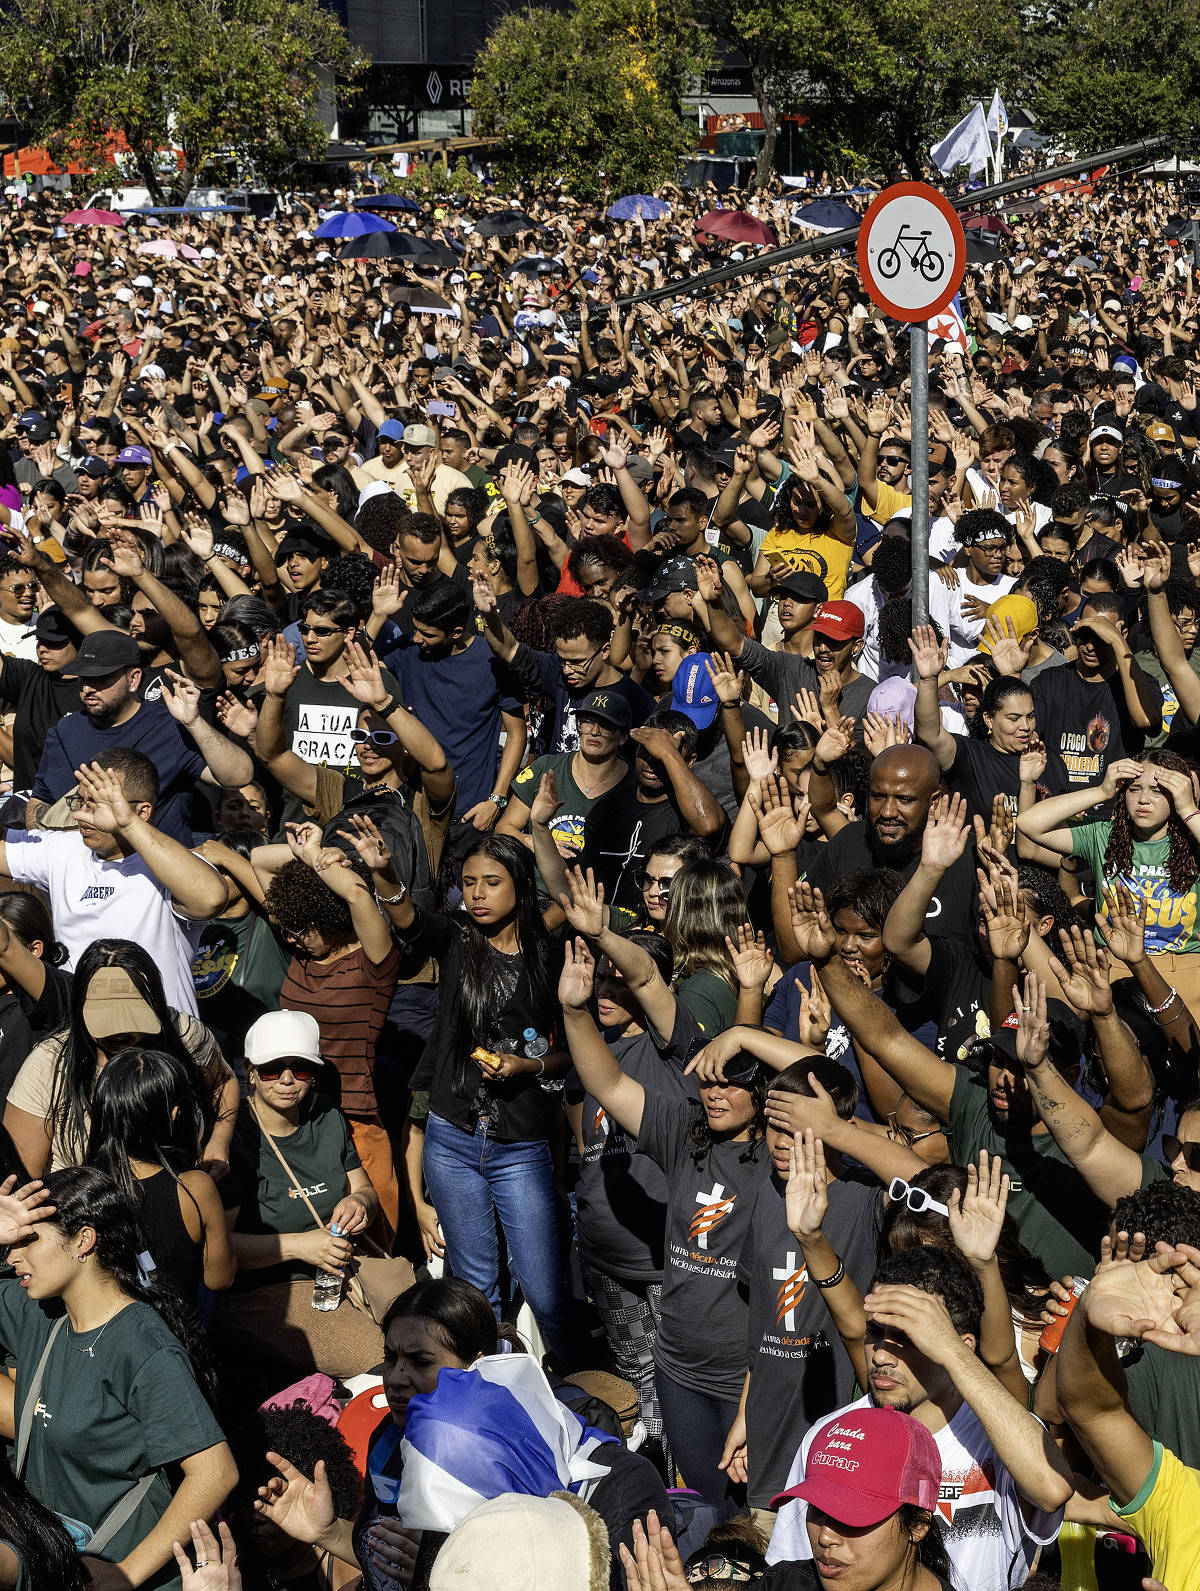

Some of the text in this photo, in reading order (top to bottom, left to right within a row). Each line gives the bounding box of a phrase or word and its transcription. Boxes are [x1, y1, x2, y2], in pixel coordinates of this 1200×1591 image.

[712, 77, 741, 87] Amazonas
[226, 643, 260, 662] JES
[300, 712, 353, 733] A TUA
[1067, 732, 1087, 753] FOGO
[826, 1422, 866, 1444] Curada
[824, 1437, 853, 1453] para
[811, 1451, 860, 1472] Curar
